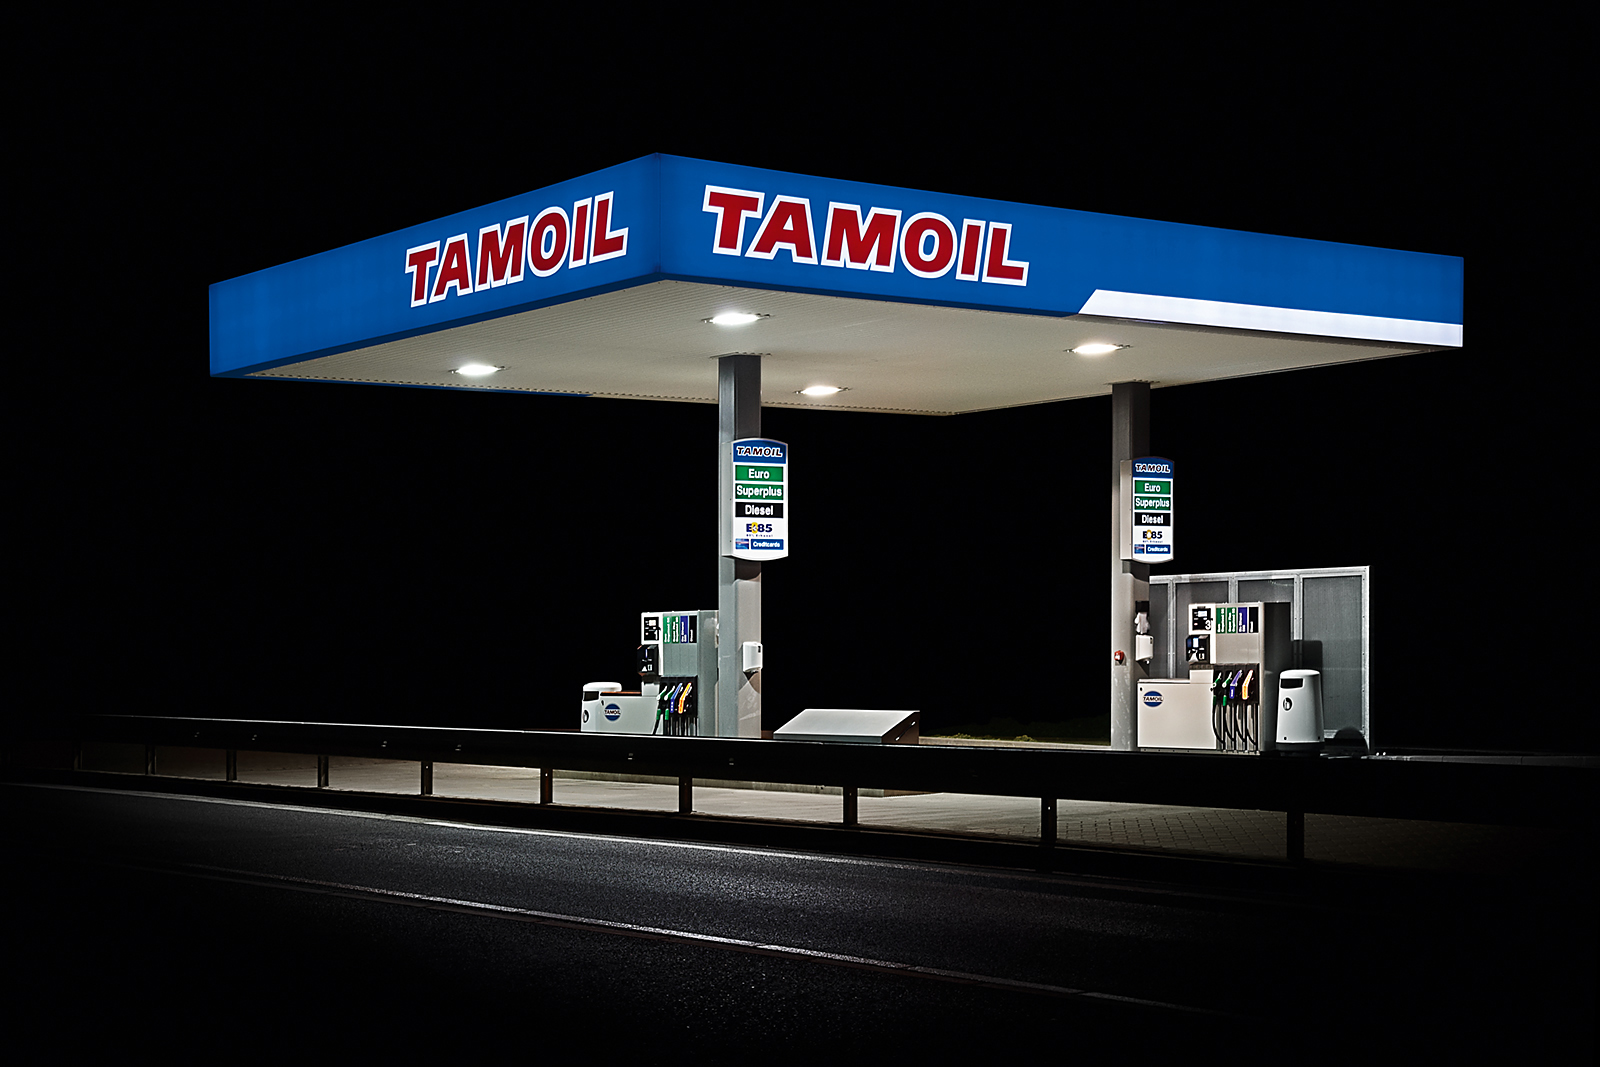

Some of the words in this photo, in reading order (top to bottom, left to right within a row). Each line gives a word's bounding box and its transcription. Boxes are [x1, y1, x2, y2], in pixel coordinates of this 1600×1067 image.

[703, 184, 1029, 287] TAMOIL
[405, 191, 628, 307] TAMOIL
[736, 446, 783, 457] TAMOIL
[748, 468, 770, 479] Euro
[1135, 463, 1171, 473] TAMOIL
[736, 485, 782, 498] Superplus
[1144, 483, 1161, 492] Euro
[1135, 497, 1170, 508] Superplus
[745, 504, 774, 515] Diesel
[1141, 514, 1164, 524] Diesel
